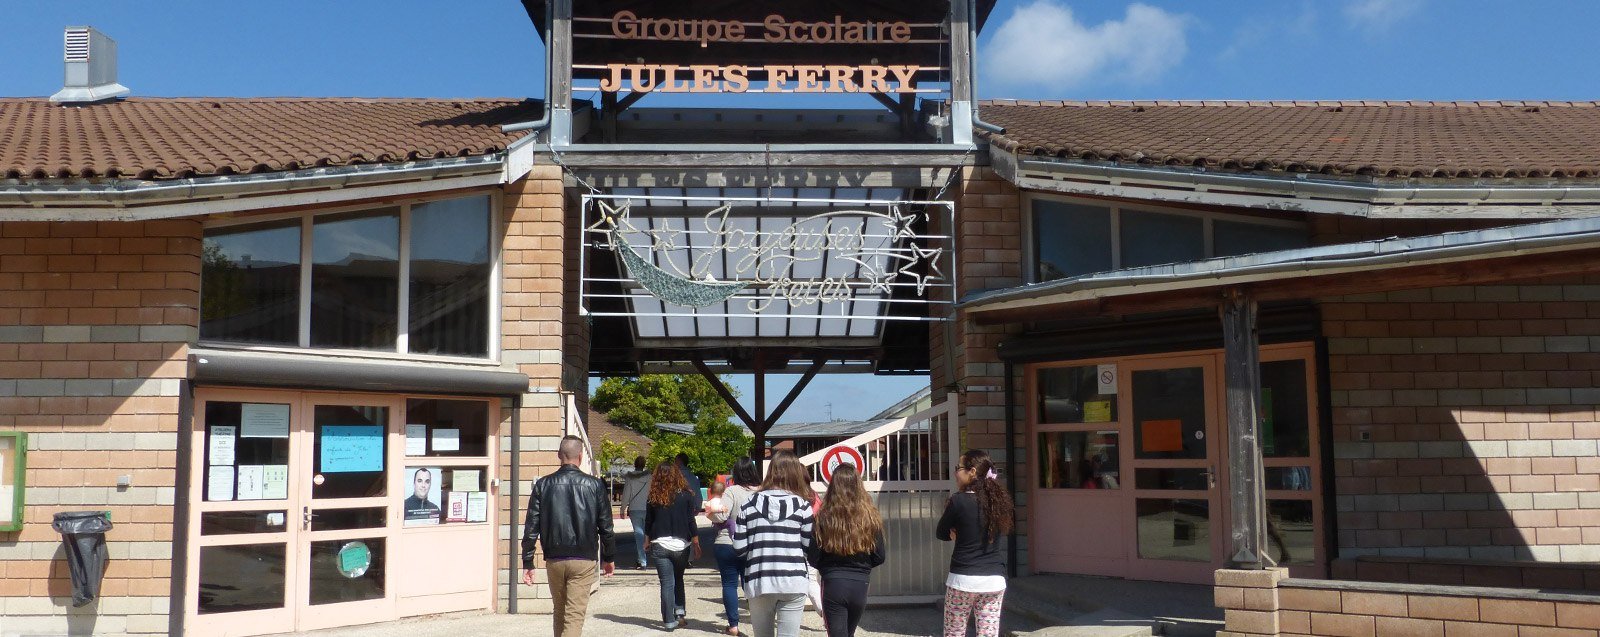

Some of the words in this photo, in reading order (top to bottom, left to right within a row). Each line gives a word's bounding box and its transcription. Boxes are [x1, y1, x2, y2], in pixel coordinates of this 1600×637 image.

[611, 10, 746, 48] Groupe
[763, 13, 911, 44] Scolaire
[600, 63, 750, 94] JULES
[763, 64, 920, 94] FERRY
